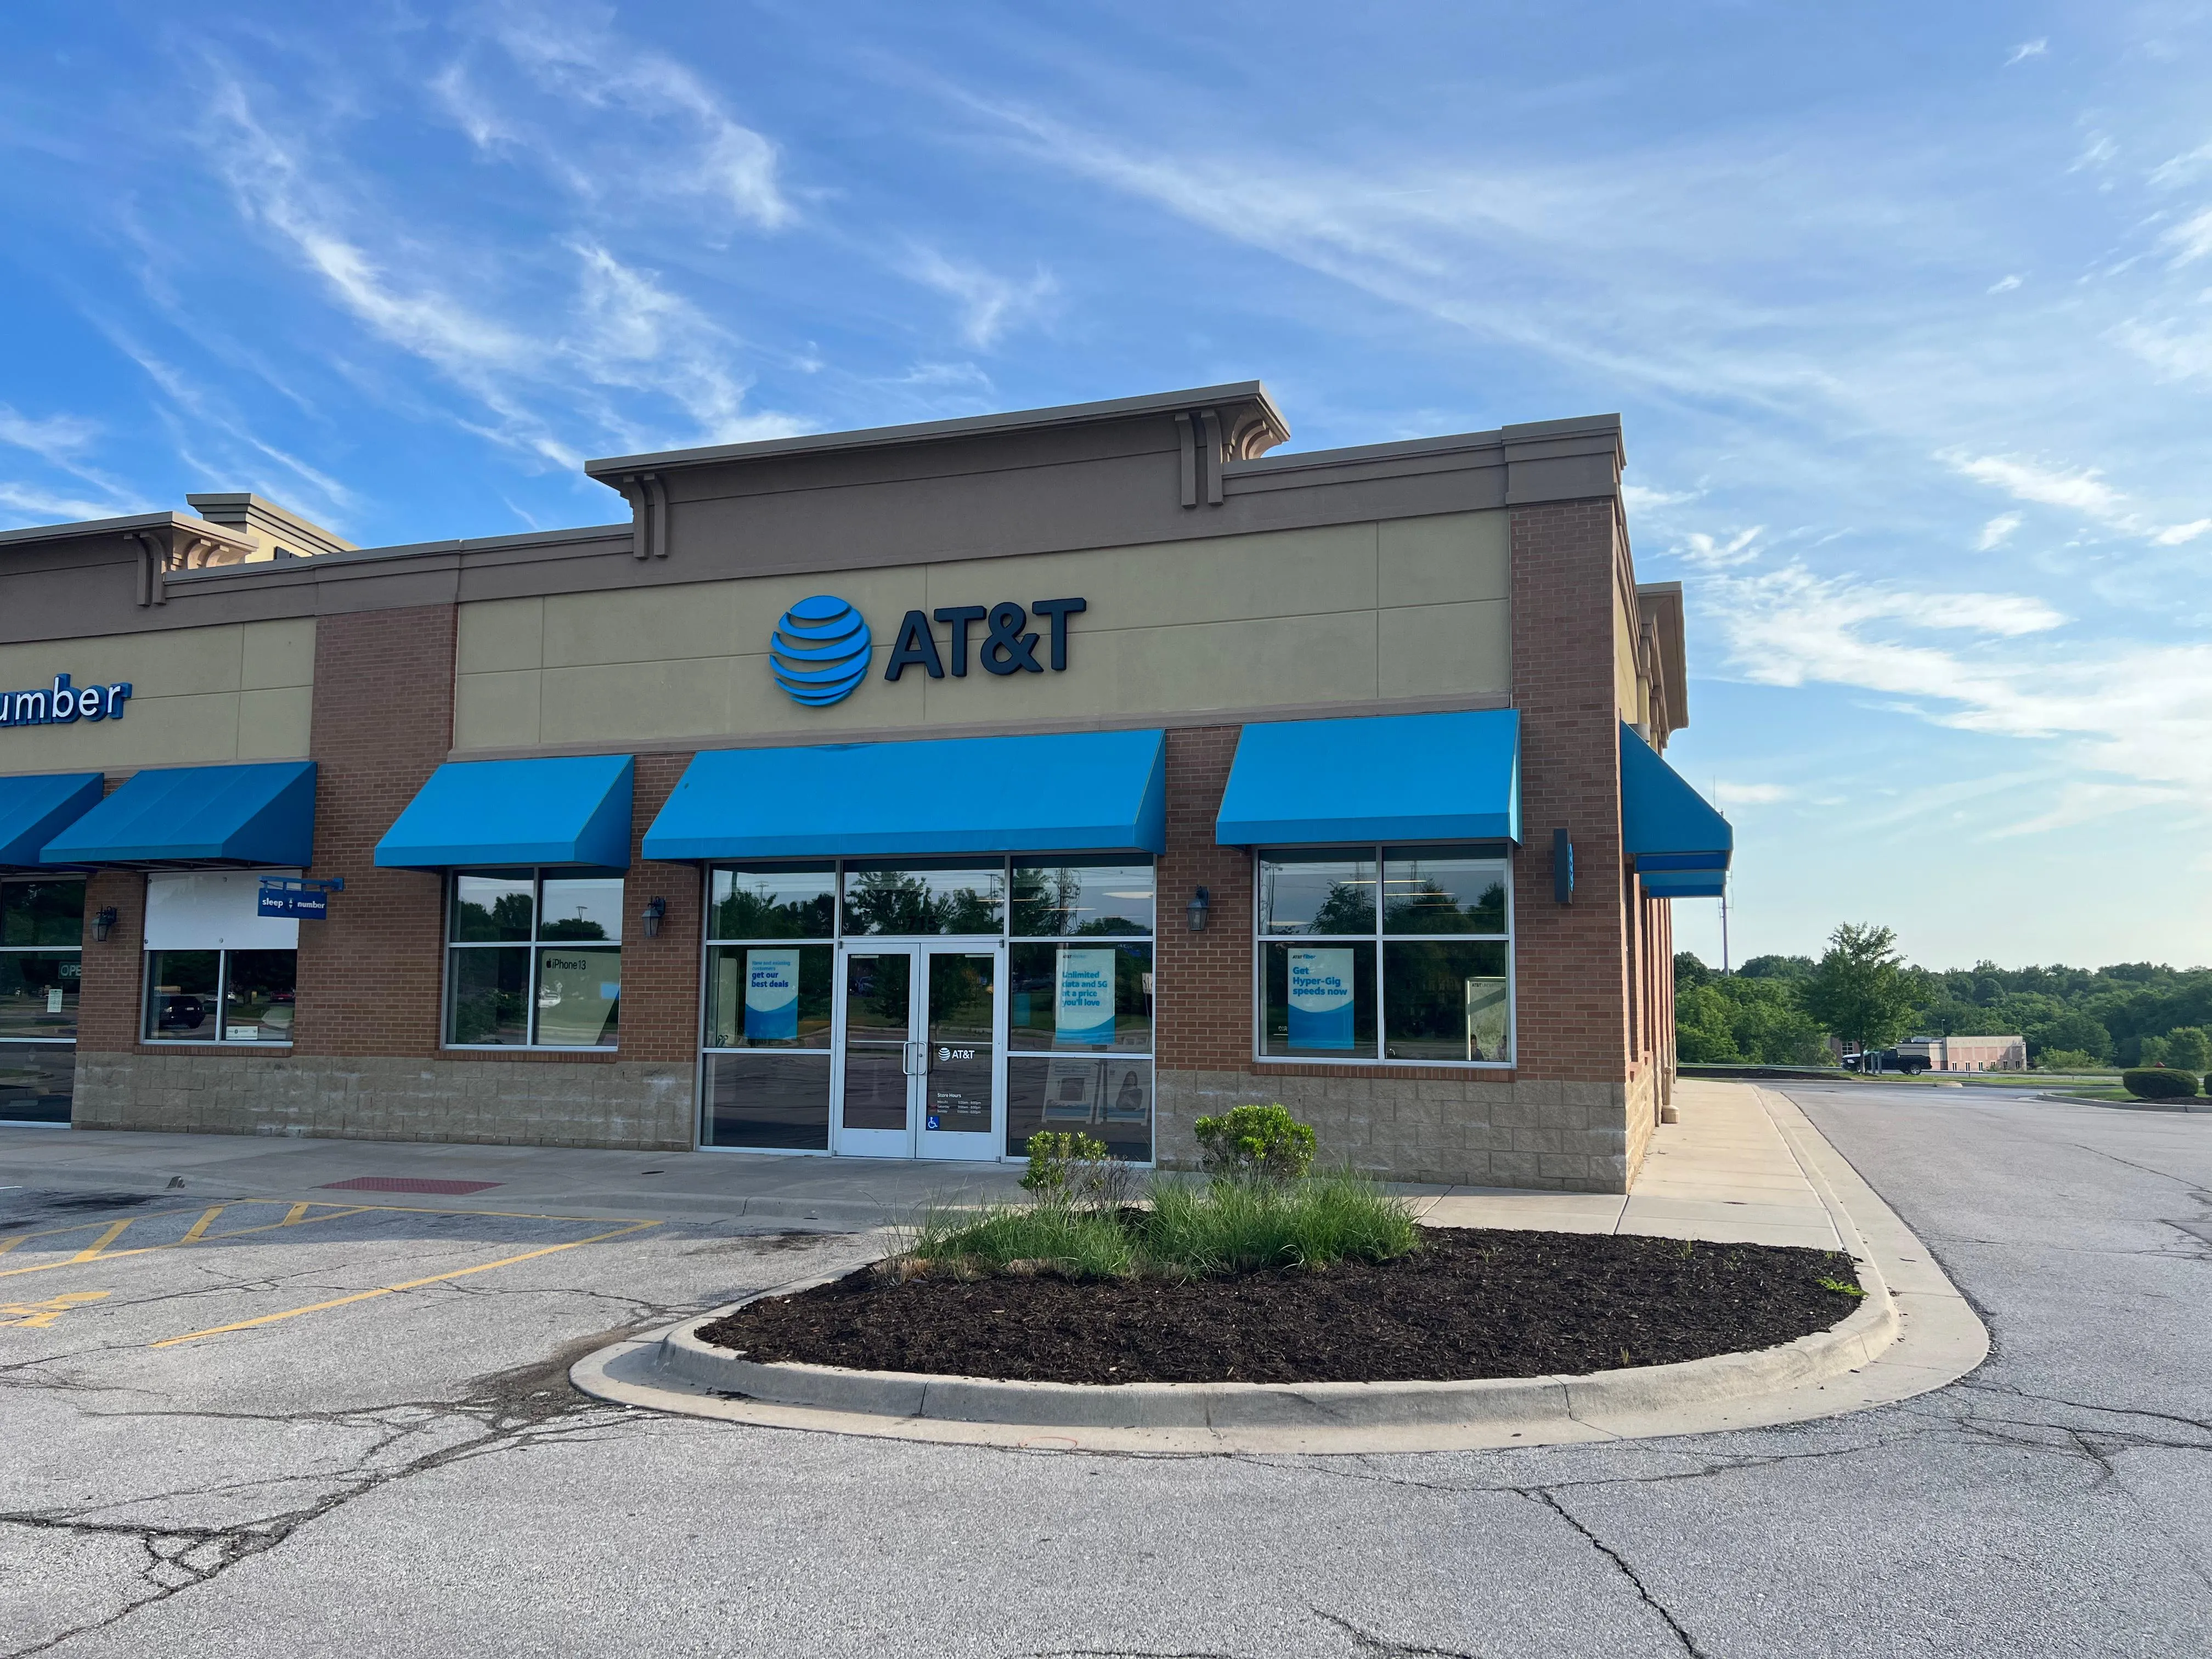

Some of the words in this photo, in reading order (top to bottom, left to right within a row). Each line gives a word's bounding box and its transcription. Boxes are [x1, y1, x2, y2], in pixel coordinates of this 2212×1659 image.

[884, 597, 1086, 681] AT&T
[262, 898, 283, 909] sleep
[552, 958, 578, 969] iPhone
[578, 960, 586, 970] 13
[752, 972, 765, 980] get
[1293, 977, 1341, 987] Hyper-Gig
[1078, 990, 1098, 998] price
[1293, 986, 1325, 997] speeds
[1062, 998, 1082, 1007] you'll
[951, 1049, 975, 1059] AT&T
